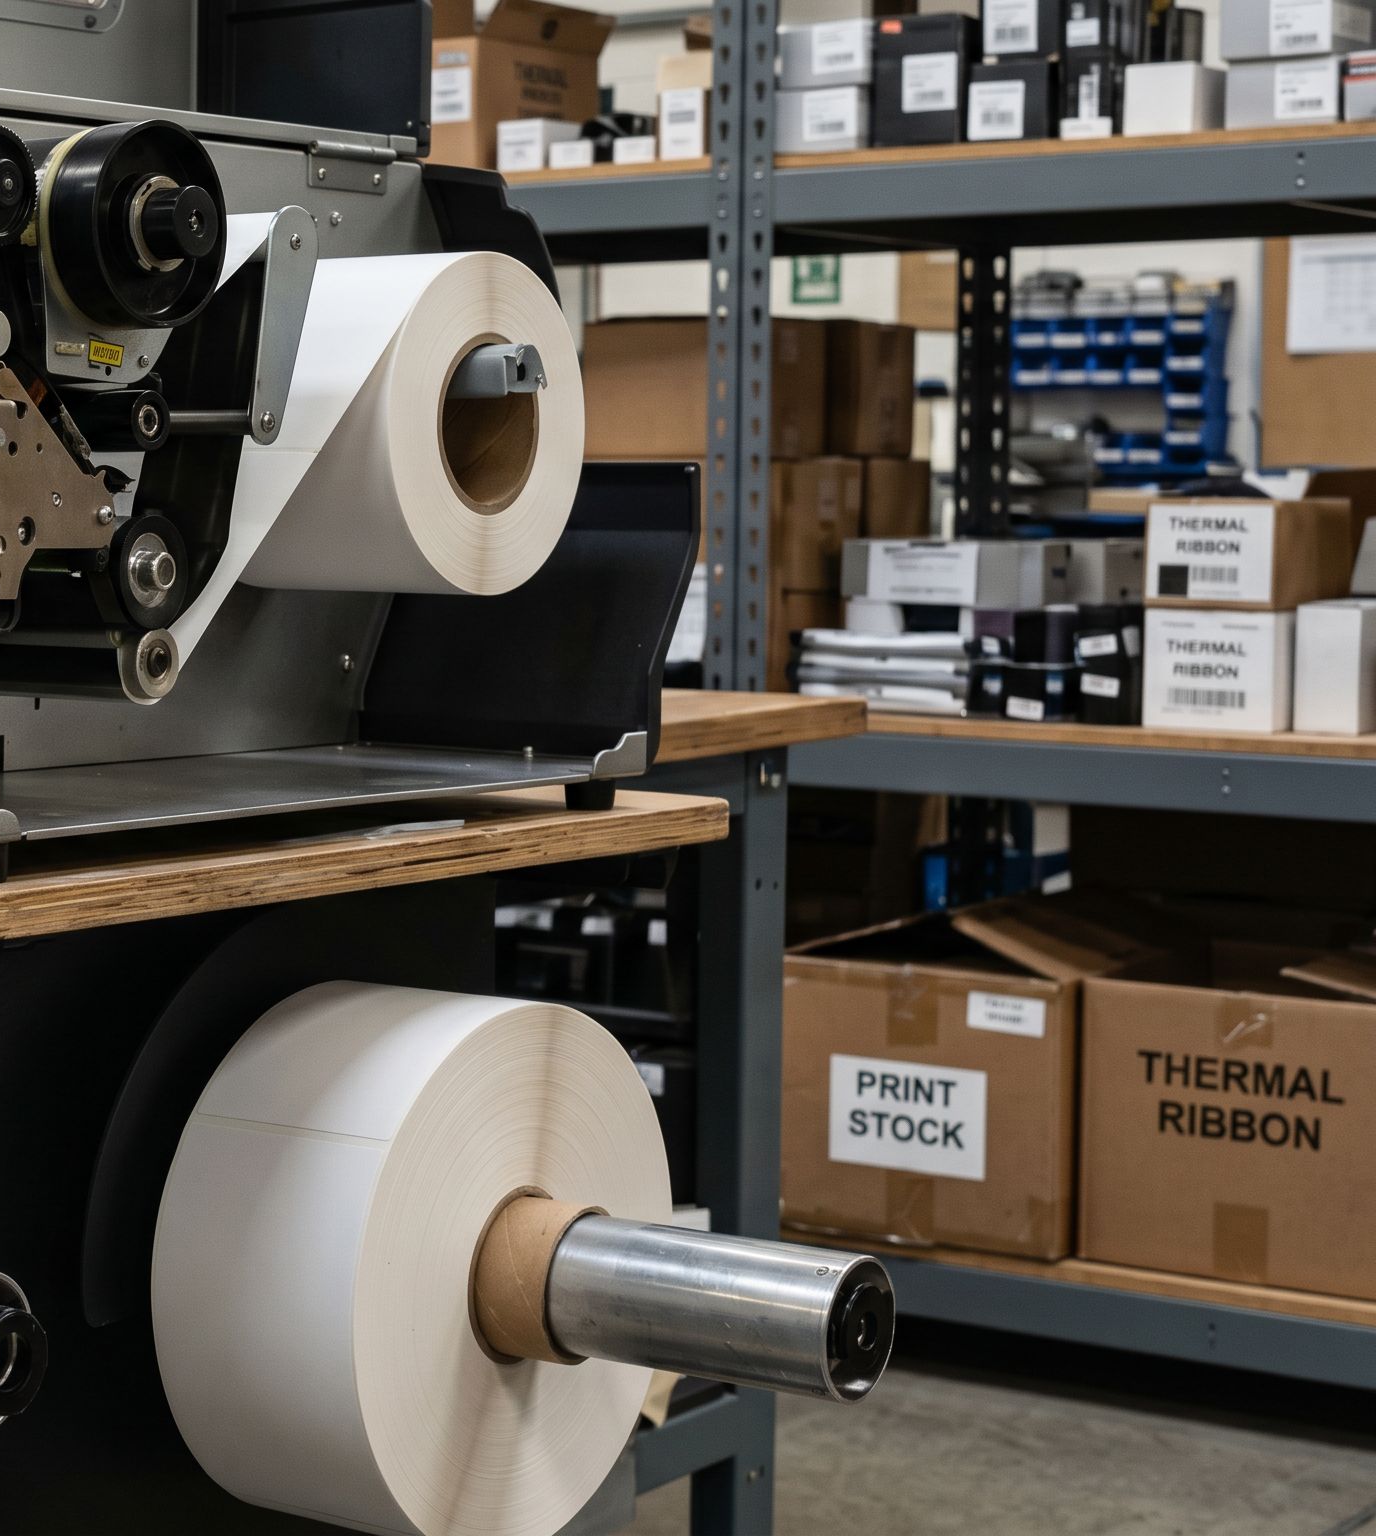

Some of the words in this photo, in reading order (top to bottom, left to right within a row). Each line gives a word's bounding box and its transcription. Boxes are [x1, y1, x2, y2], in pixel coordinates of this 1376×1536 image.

[1169, 516, 1248, 533] THERMAL
[1176, 539, 1240, 555] RIBBON
[1166, 639, 1247, 657] THERMAL
[1173, 662, 1239, 679] RIBBON
[856, 1070, 958, 1108] PRINT
[1137, 1048, 1346, 1106] THERMAL
[848, 1109, 965, 1150] STOCK
[1158, 1100, 1323, 1153] RIBBON
